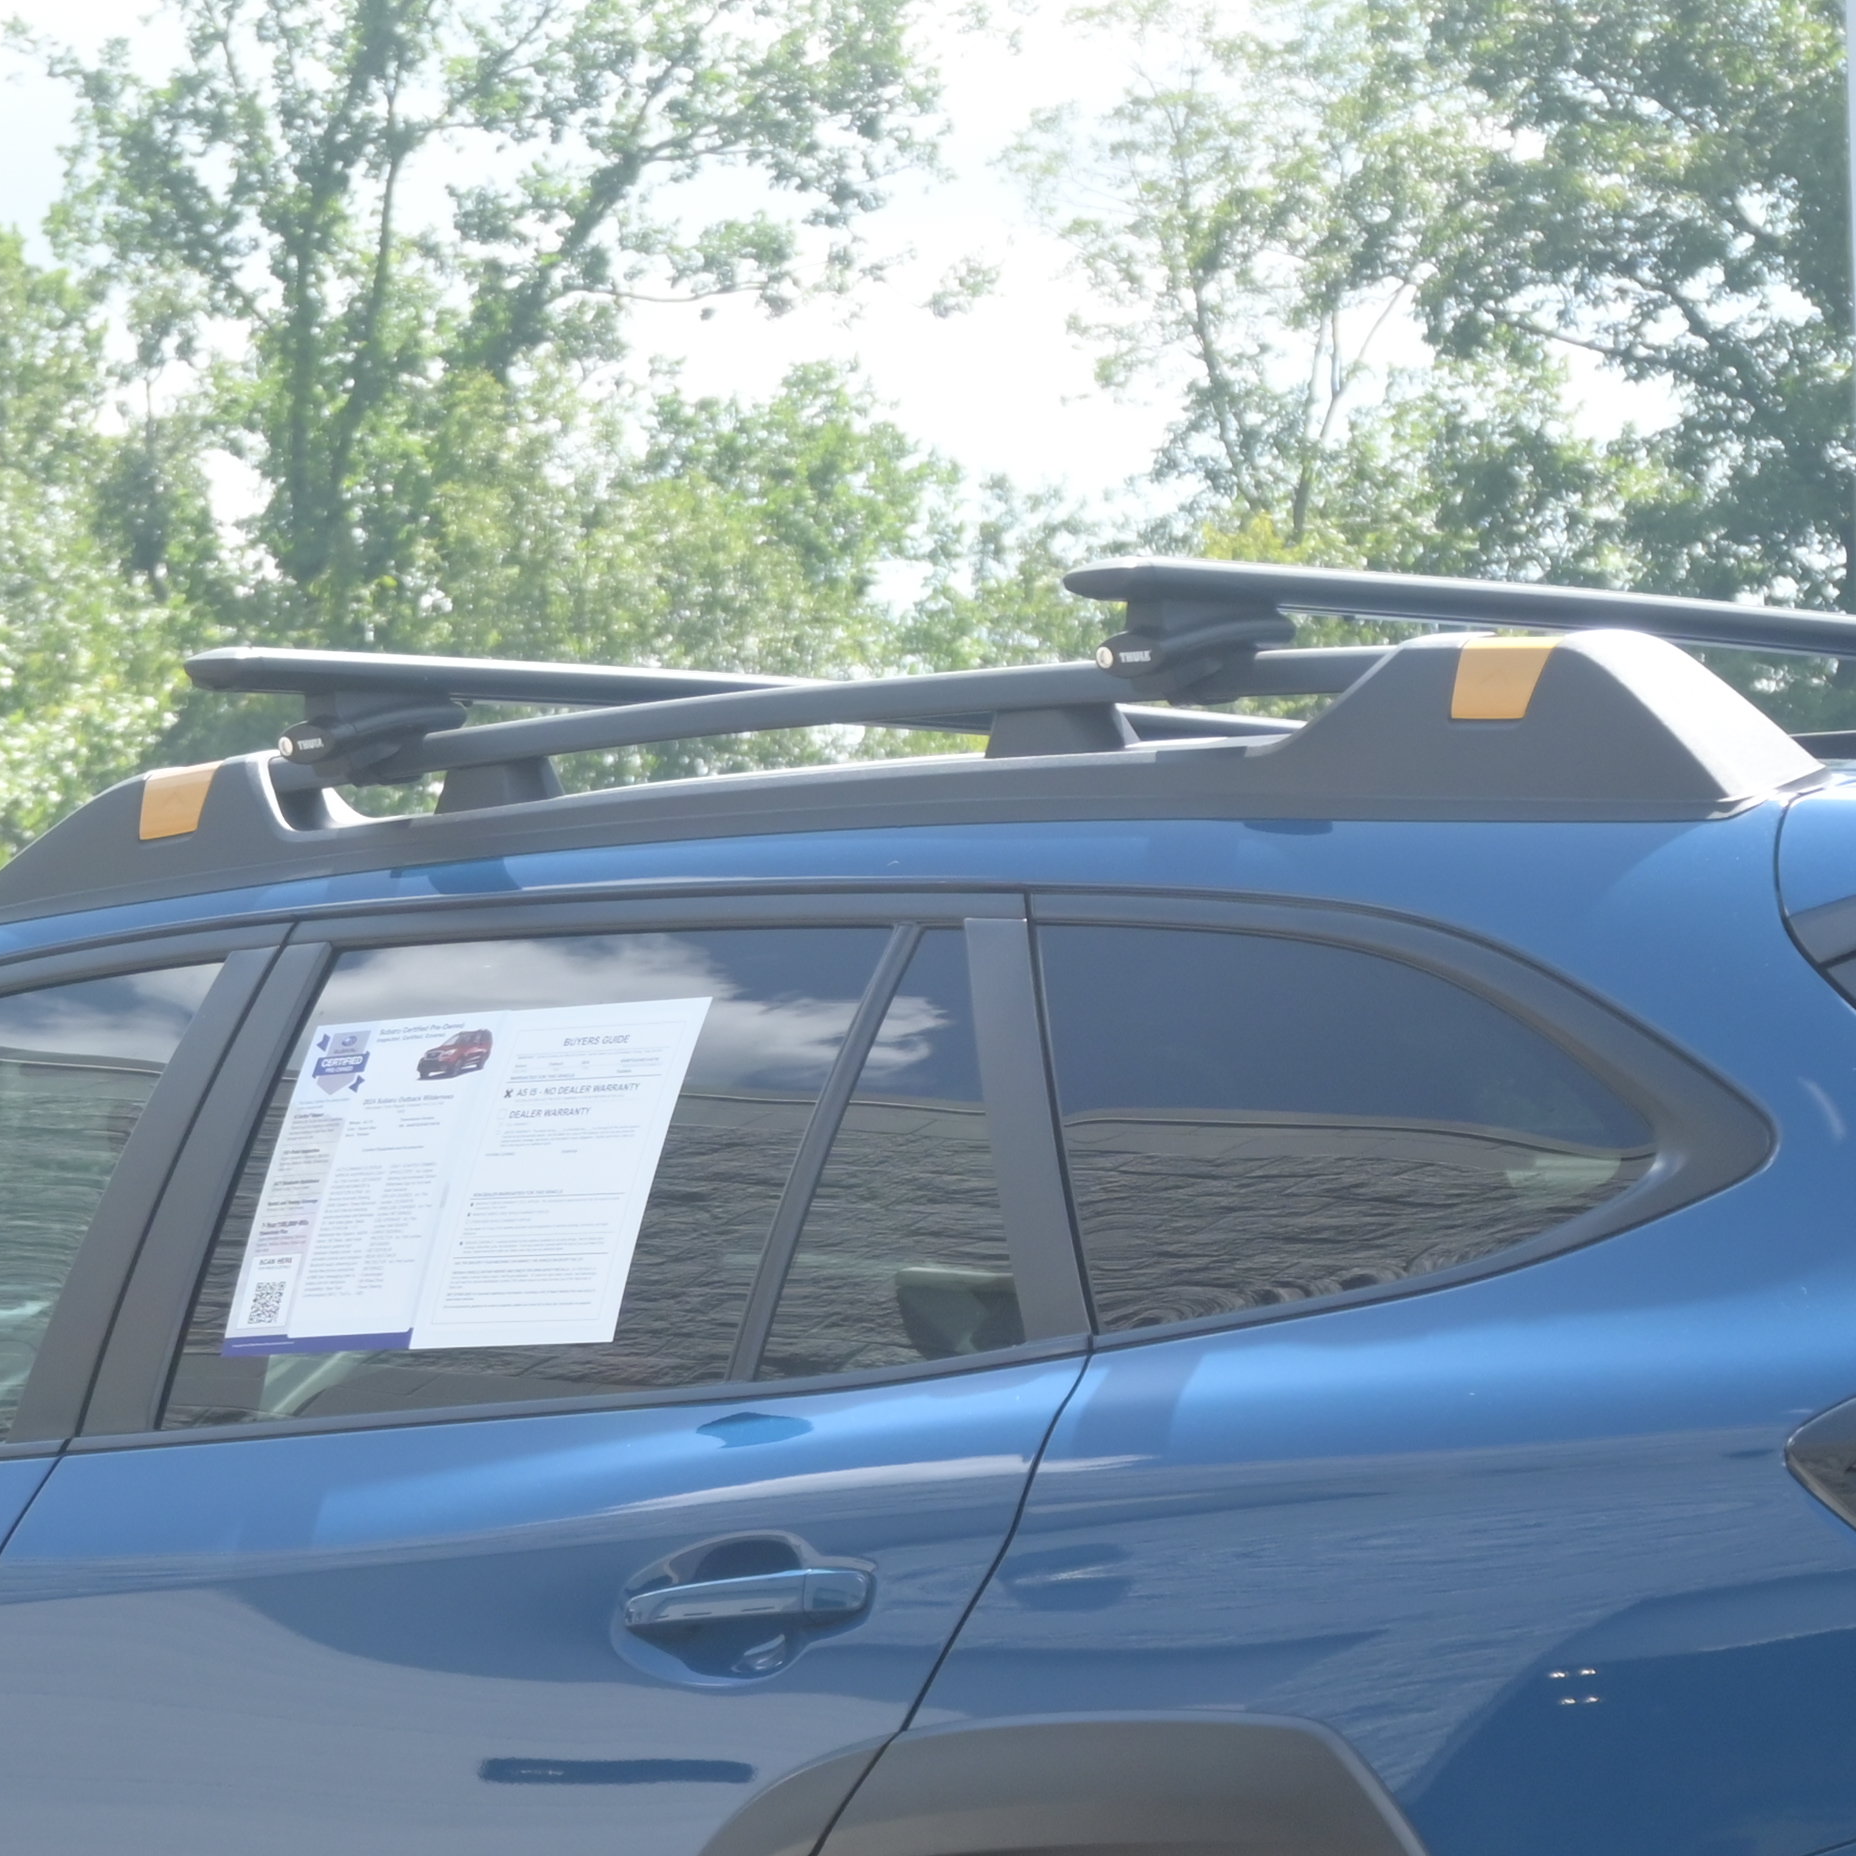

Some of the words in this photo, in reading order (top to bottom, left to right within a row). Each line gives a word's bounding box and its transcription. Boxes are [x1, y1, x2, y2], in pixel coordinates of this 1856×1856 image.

[563, 1036, 600, 1047] BUYERS
[601, 1034, 631, 1045] GUIDE
[321, 1055, 364, 1068] CERTIFIED
[516, 1089, 528, 1097] AS
[544, 1087, 557, 1096] NO
[557, 1085, 592, 1095] DEALER
[593, 1083, 641, 1093] WARRANTY
[508, 1109, 543, 1119] DEALER
[544, 1107, 592, 1117] WARRANTY
